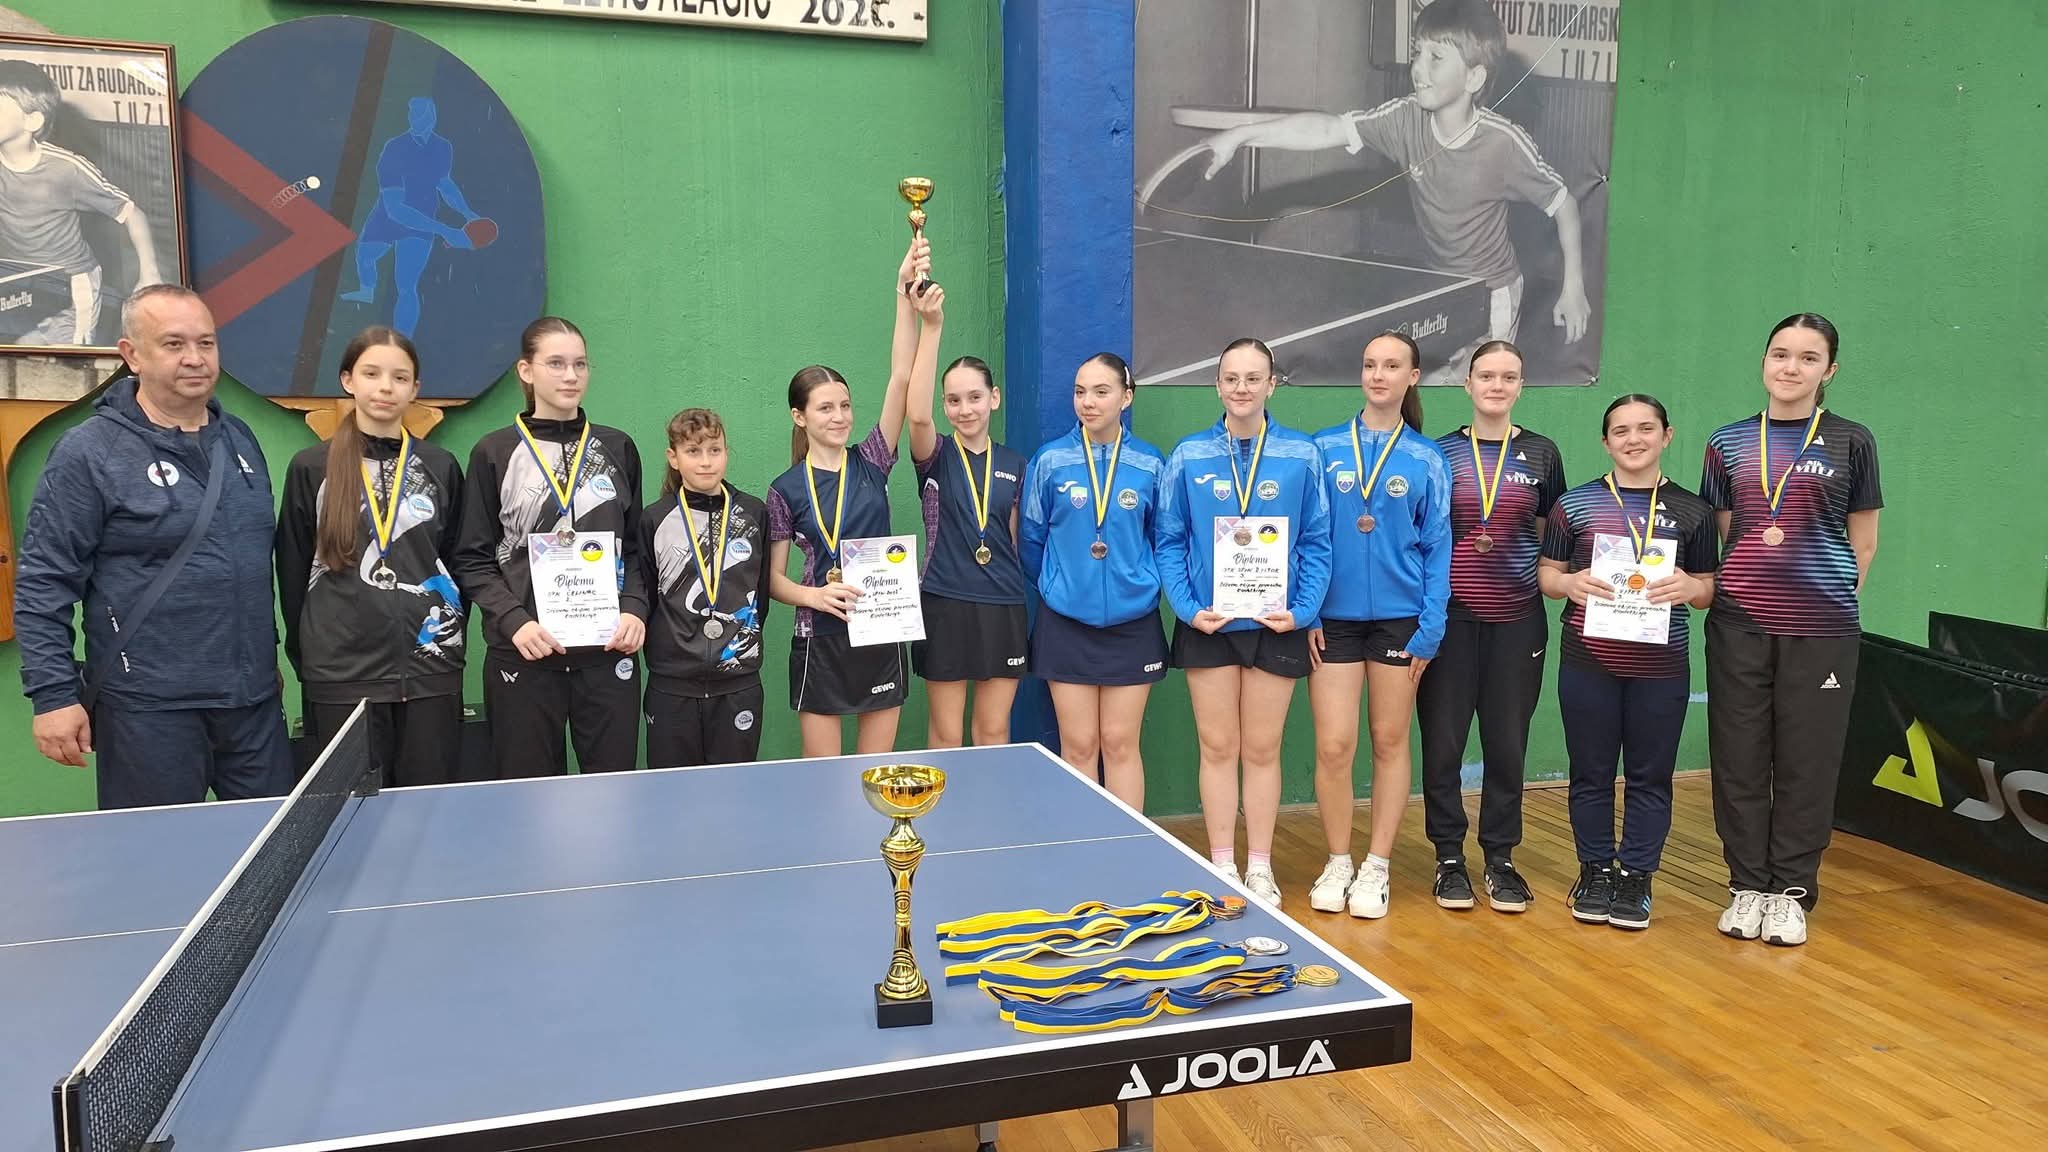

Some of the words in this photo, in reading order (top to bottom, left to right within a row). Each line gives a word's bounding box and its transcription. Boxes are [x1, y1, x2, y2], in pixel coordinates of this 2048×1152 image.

[1527, 2, 1545, 36] ZA
[77, 66, 95, 92] ZA
[1411, 312, 1449, 340] Butterfly
[994, 471, 1017, 483] GEWO
[1233, 552, 1268, 565] Diploma
[554, 574, 594, 588] Diploma
[862, 575, 899, 588] Diploma
[1007, 656, 1025, 666] GEWO
[871, 682, 896, 695] GEWO
[1159, 1039, 1337, 1095] JOOLA
